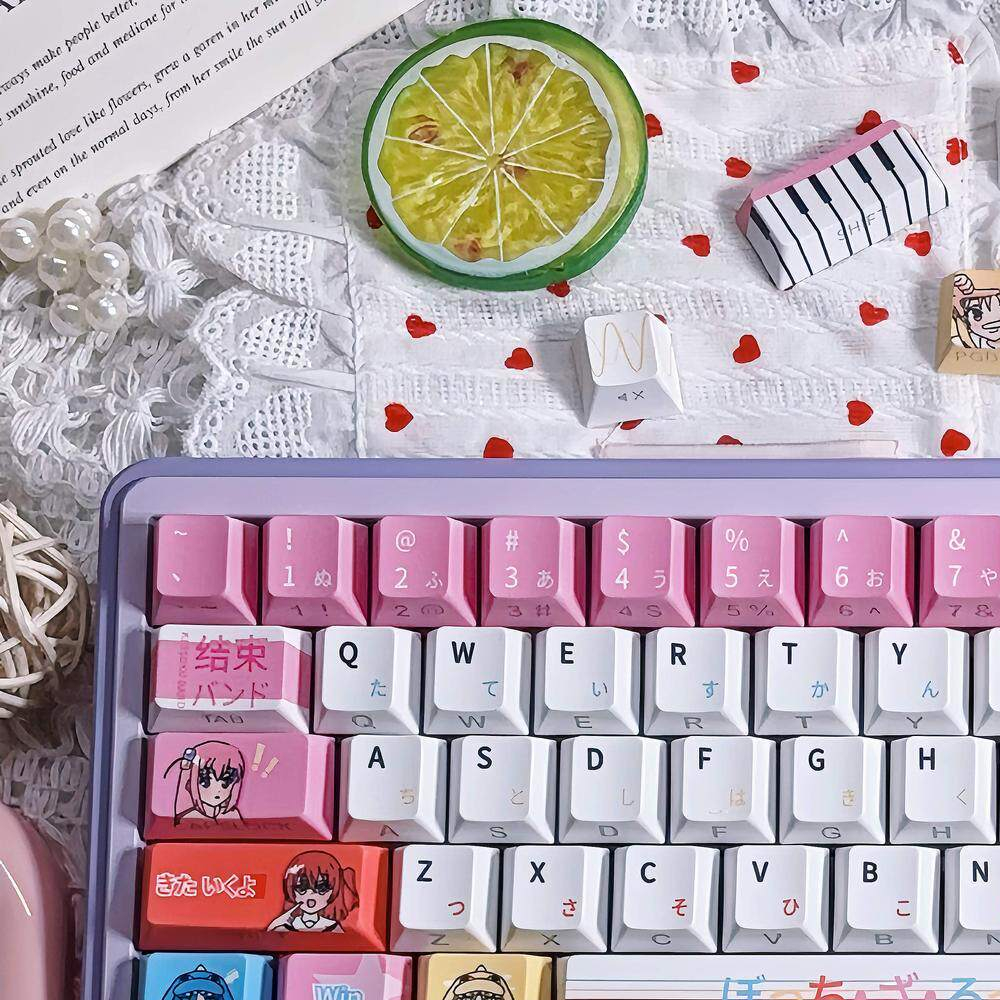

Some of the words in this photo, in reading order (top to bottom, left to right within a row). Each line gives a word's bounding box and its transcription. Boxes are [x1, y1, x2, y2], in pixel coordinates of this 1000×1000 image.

[31, 46, 62, 71] make
[64, 20, 100, 52] people
[5, 82, 59, 121] sunshine,
[60, 58, 85, 87] food
[87, 42, 110, 66] and
[160, 1, 176, 21] for
[10, 138, 57, 177] sprouted
[57, 124, 83, 144] love
[82, 107, 106, 127] like
[107, 81, 152, 115] flowers,
[182, 52, 191, 62] a
[225, 20, 240, 33] in
[240, 6, 259, 23] her
[1, 191, 24, 214] and
[53, 165, 68, 179] on
[70, 150, 88, 167] the
[90, 119, 130, 154] normal
[165, 82, 191, 108] from
[191, 68, 210, 86] her
[213, 47, 243, 72] smile
[246, 34, 262, 51] the
[266, 20, 287, 38] sun
[289, 0, 312, 23] still
[284, 566, 295, 586] 1
[315, 569, 331, 586] ぬ
[395, 568, 407, 588] 2
[426, 571, 442, 588] ふ
[505, 567, 517, 588] 3
[537, 570, 553, 588] あ
[615, 568, 629, 589] 4
[653, 570, 665, 588] う
[725, 566, 737, 587] 5
[758, 569, 773, 587] え
[836, 566, 848, 587] 6
[867, 569, 884, 587] お
[949, 565, 961, 586] 7
[980, 568, 997, 586] や
[339, 642, 358, 668] Q
[452, 641, 475, 664] W
[561, 642, 574, 664] E
[671, 643, 686, 665] R
[782, 642, 798, 664] T
[892, 643, 907, 665] Y
[191, 681, 269, 709] バンド
[371, 679, 386, 696] た
[483, 681, 498, 696] て
[703, 681, 718, 698] す
[812, 681, 828, 698] か
[922, 681, 939, 697] ん
[368, 746, 385, 768] A
[477, 746, 492, 769] S
[588, 748, 603, 770] D
[699, 747, 712, 769] F
[809, 748, 824, 771] G
[919, 748, 935, 770] H
[417, 860, 432, 882] Z
[530, 862, 545, 883] X
[641, 862, 656, 883] C
[752, 861, 768, 882] V
[863, 862, 878, 882] B
[973, 861, 988, 882] N
[563, 899, 577, 917] さ
[672, 899, 687, 916] そ
[783, 899, 799, 915] ひ
[897, 901, 910, 916] こ
